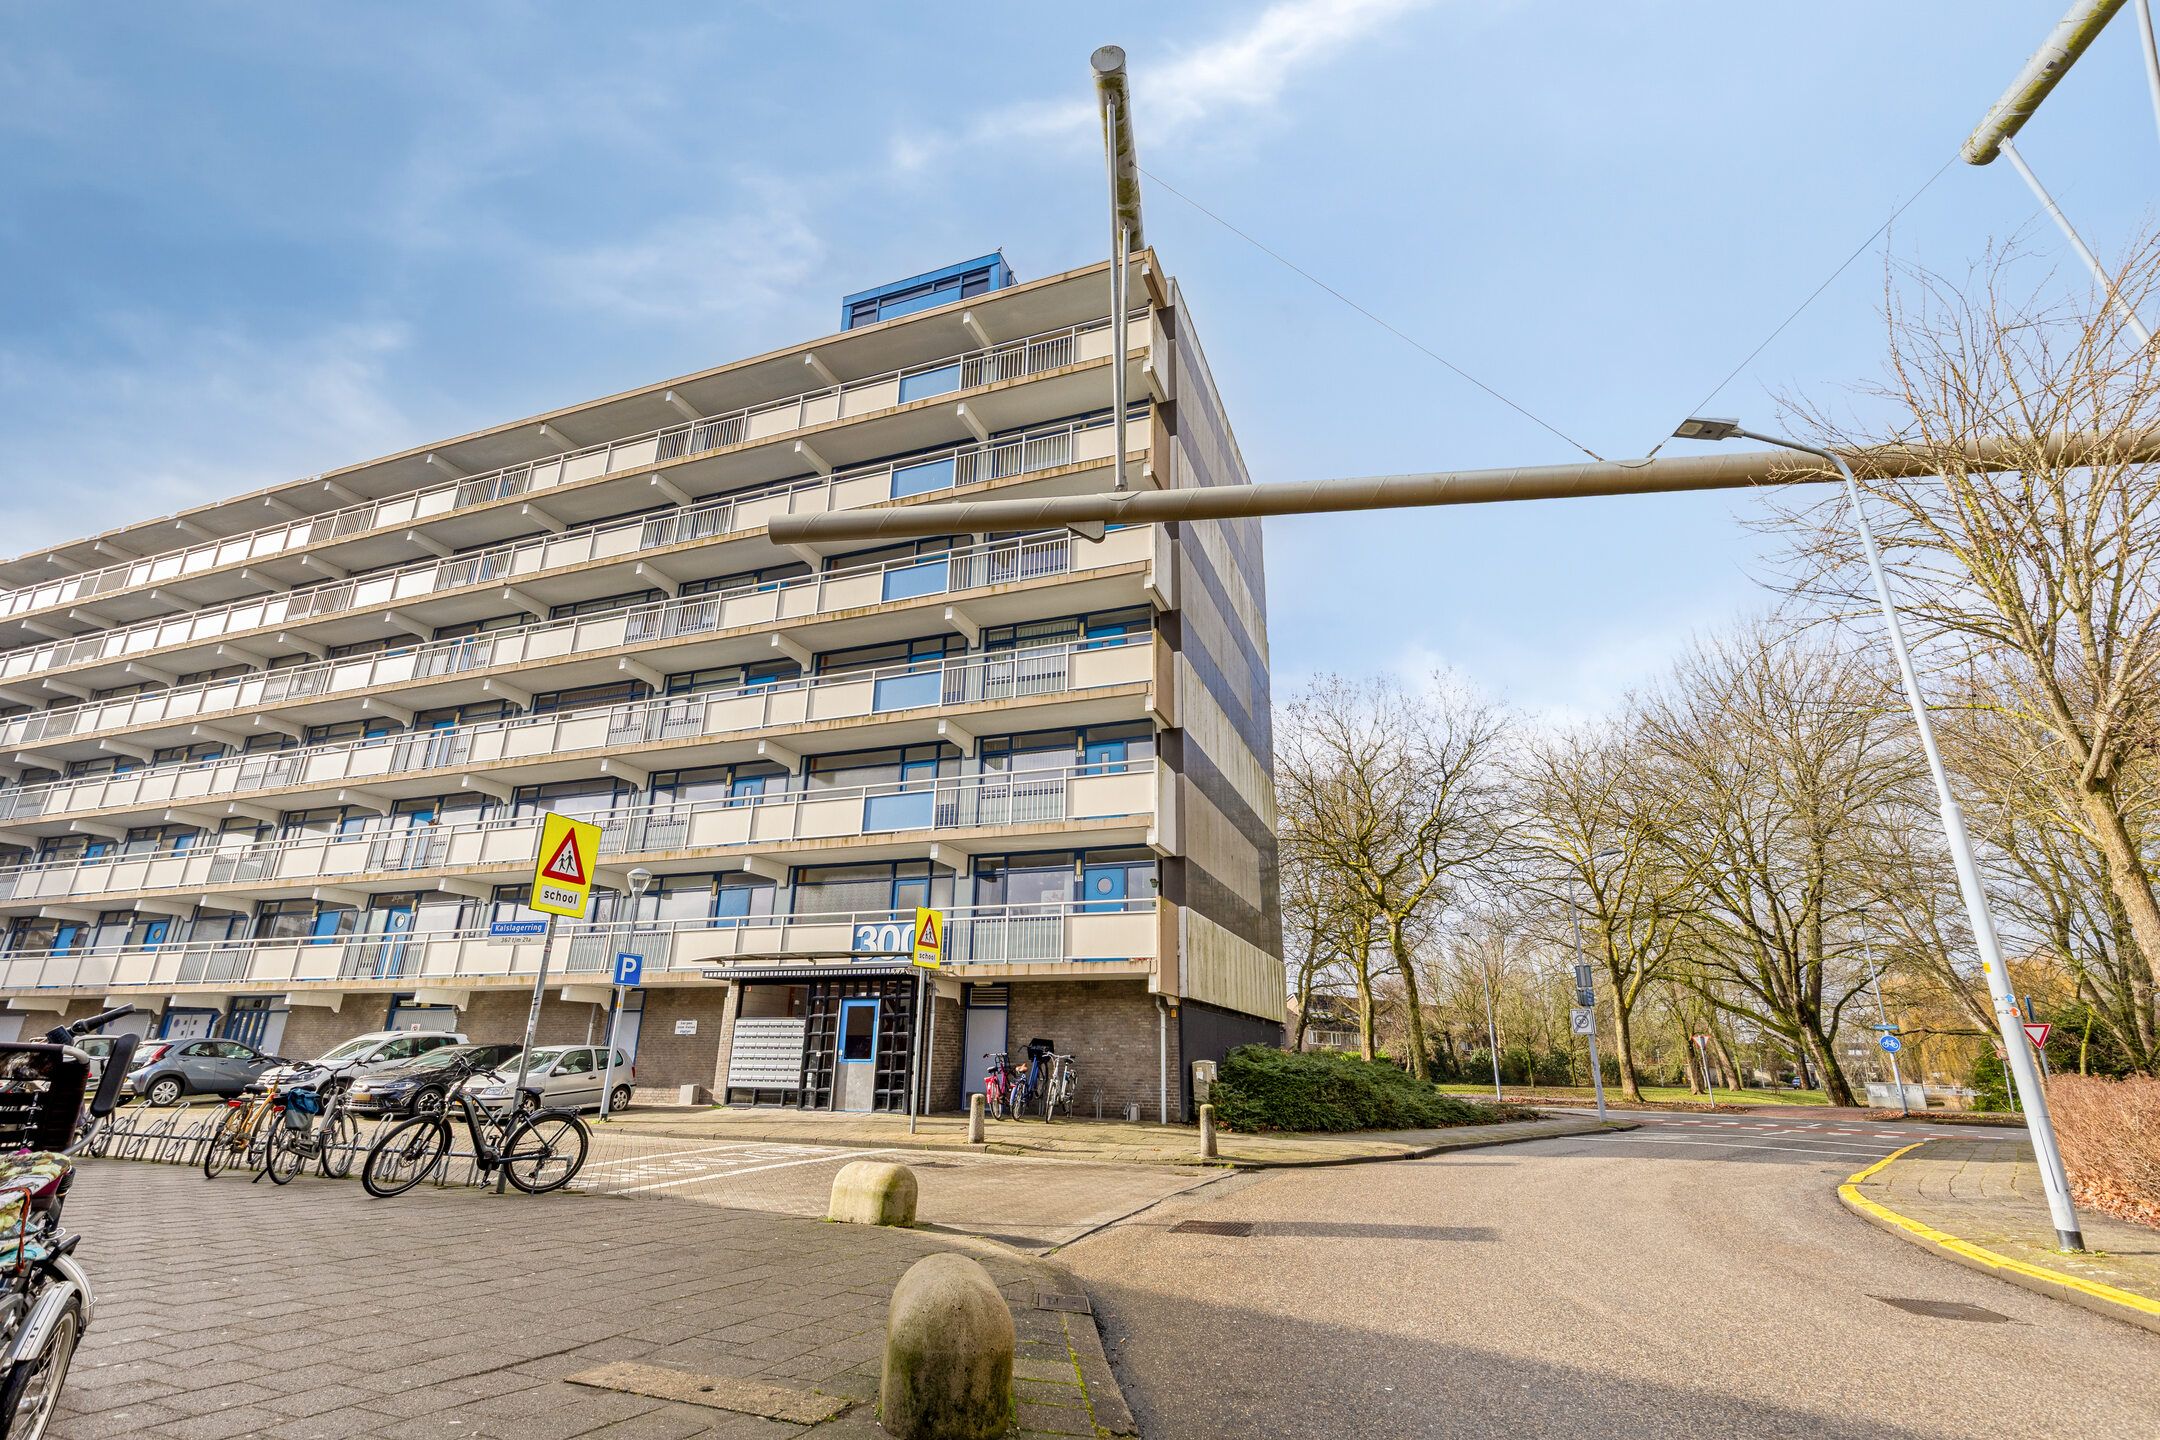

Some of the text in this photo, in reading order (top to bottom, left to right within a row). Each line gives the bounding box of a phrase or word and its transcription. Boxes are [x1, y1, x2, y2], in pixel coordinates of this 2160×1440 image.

[543, 889, 579, 905] school
[494, 923, 543, 933] Kalslagerring
[918, 951, 937, 961] school
[620, 956, 637, 981] P
